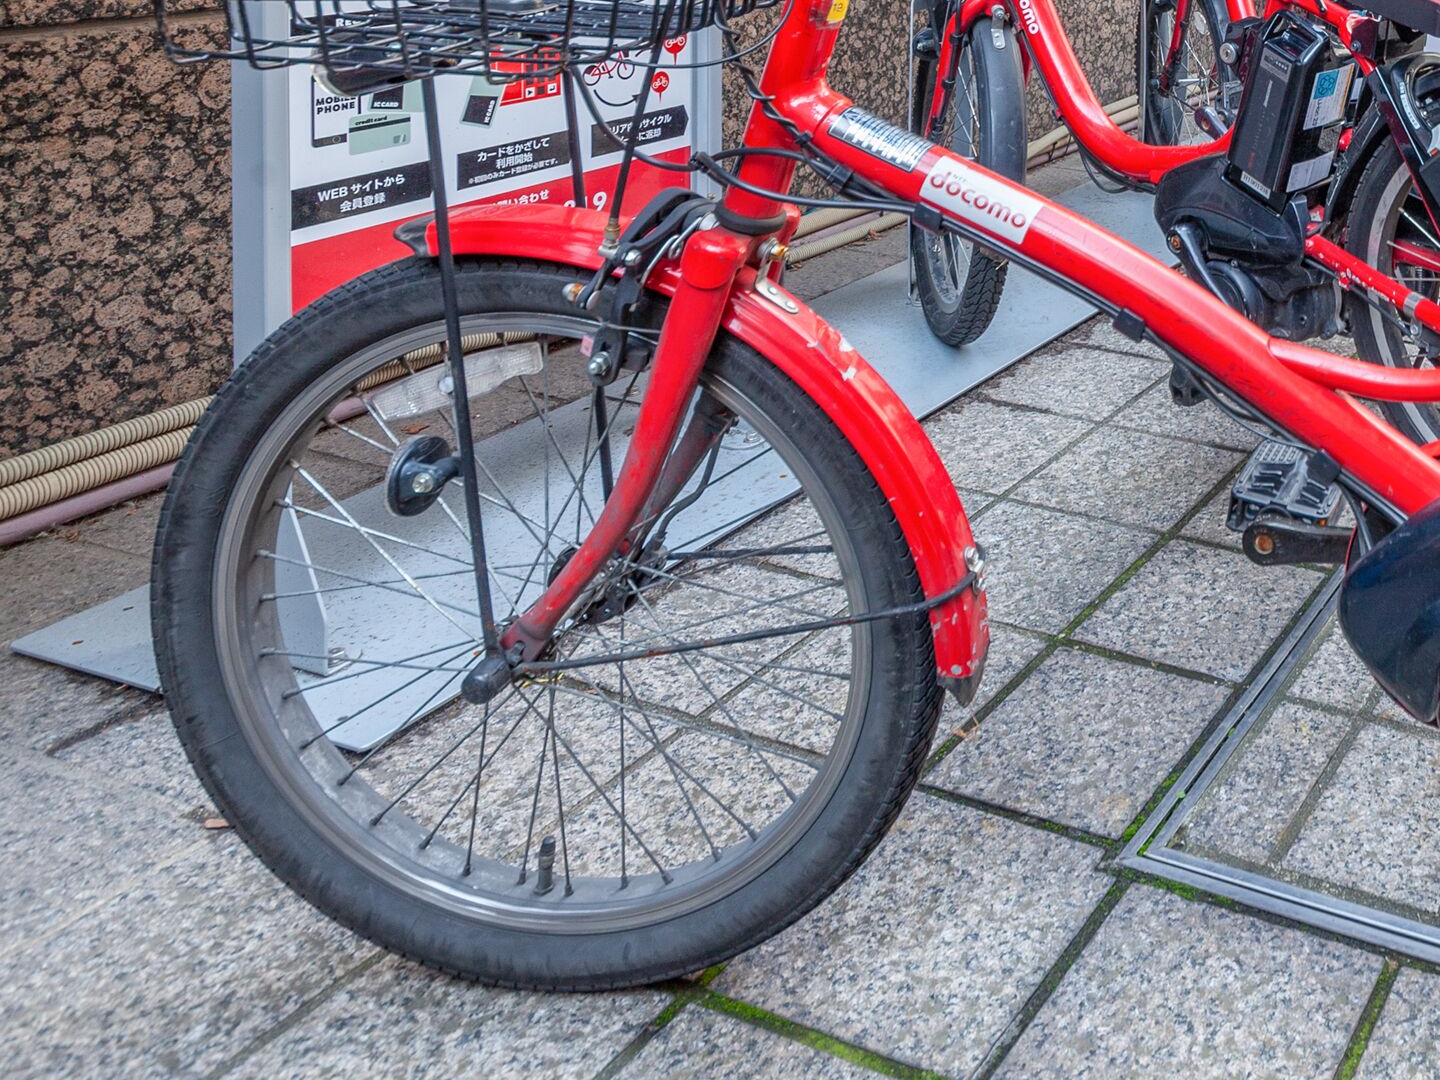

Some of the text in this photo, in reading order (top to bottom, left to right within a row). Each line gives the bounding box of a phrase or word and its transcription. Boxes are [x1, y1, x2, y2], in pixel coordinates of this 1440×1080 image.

[316, 102, 356, 115] PHONE
[355, 117, 373, 126] credit
[477, 137, 550, 162] カードをかざして
[496, 152, 533, 169] 利用開始
[318, 174, 405, 202] WEB サイトから
[340, 192, 386, 213] 会員登録
[930, 171, 1026, 228] docomo
